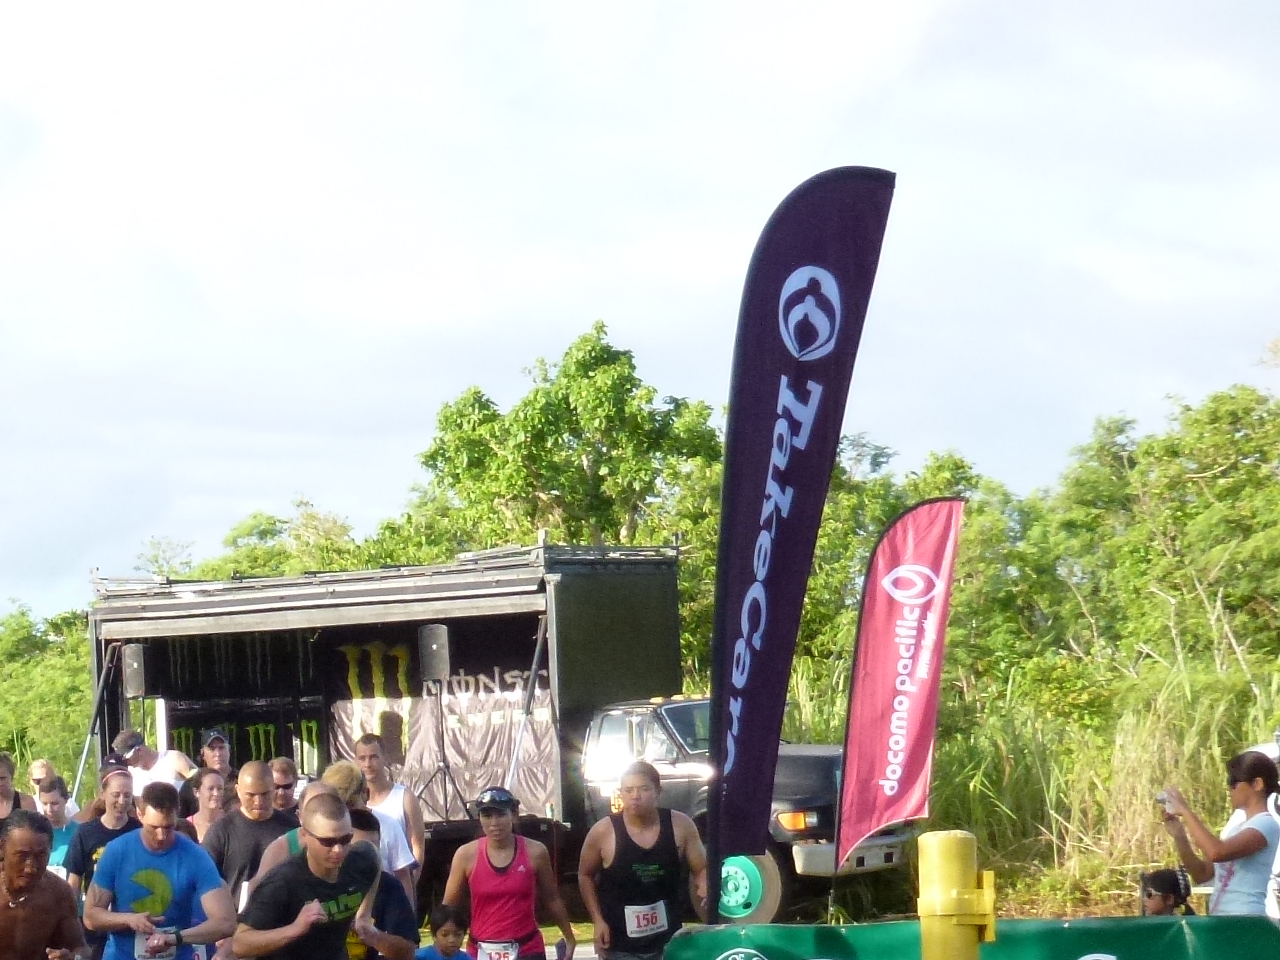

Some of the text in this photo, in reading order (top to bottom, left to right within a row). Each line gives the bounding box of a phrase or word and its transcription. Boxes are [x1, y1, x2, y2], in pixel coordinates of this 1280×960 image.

[878, 606, 921, 796] docomo pacific
[634, 911, 658, 929] 156
